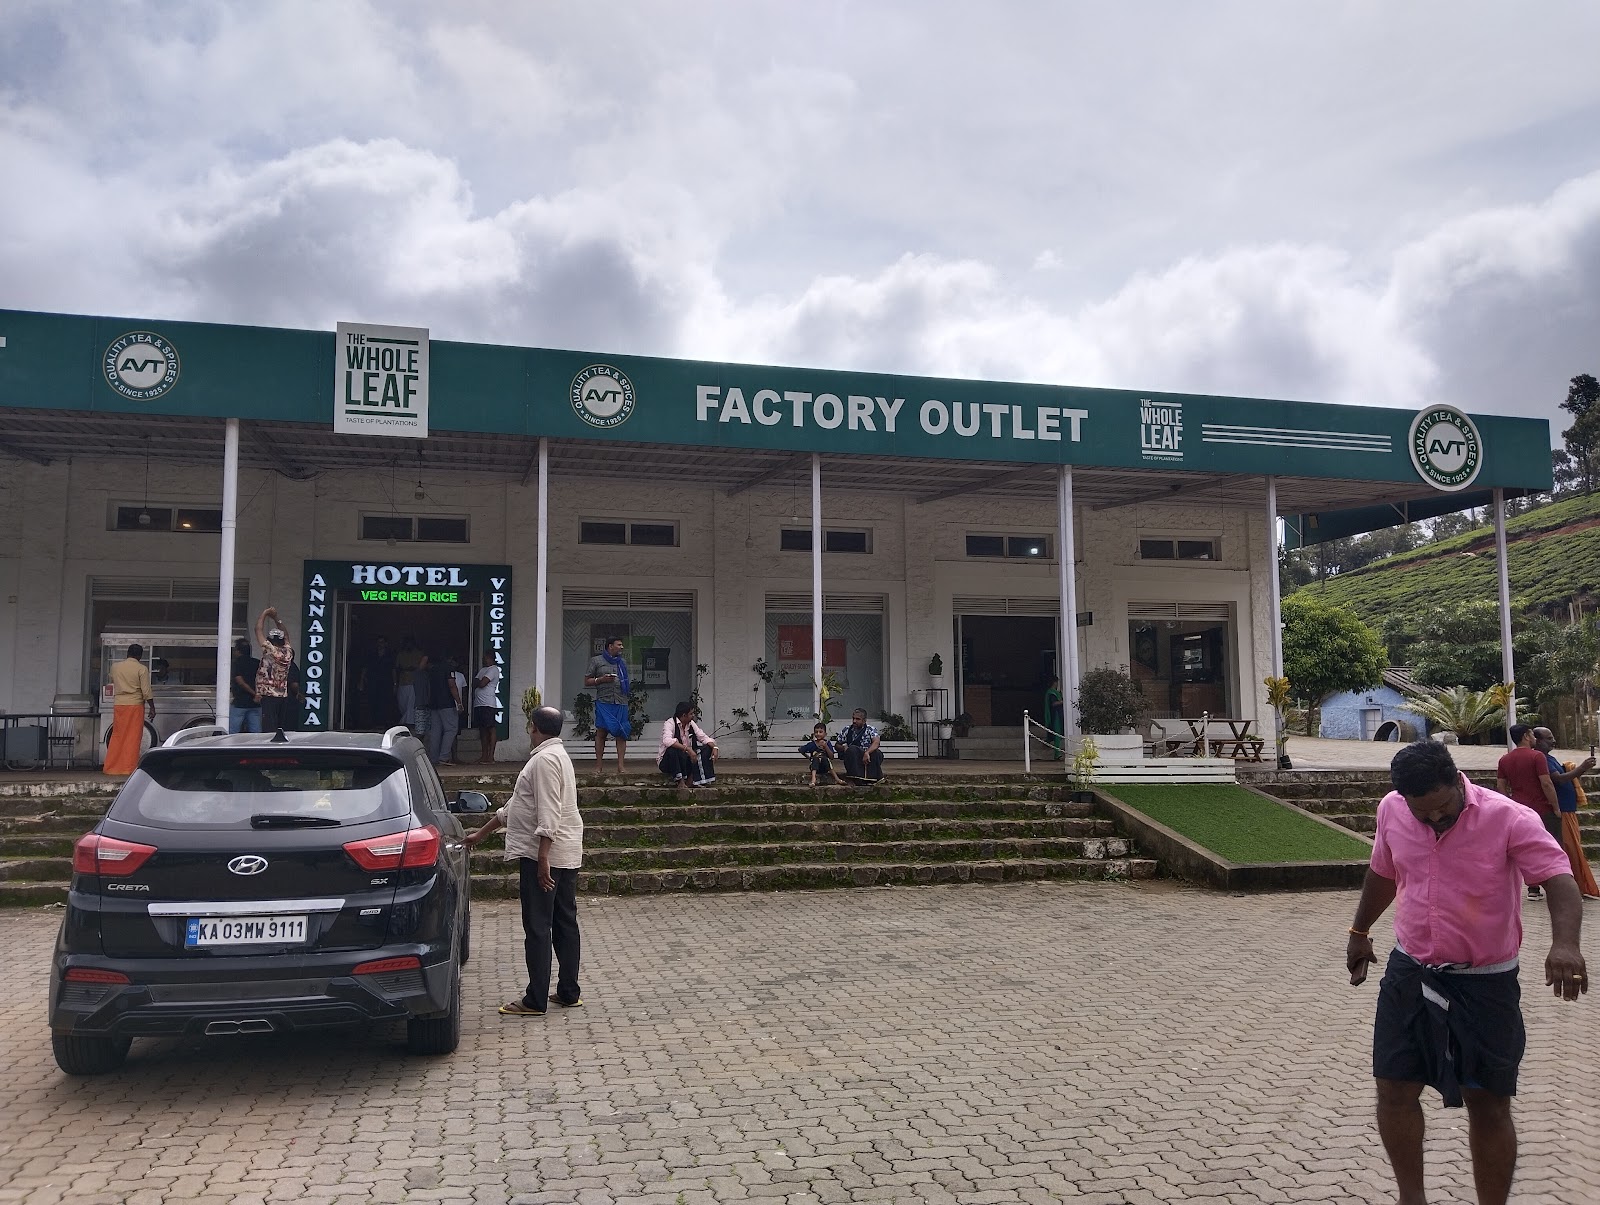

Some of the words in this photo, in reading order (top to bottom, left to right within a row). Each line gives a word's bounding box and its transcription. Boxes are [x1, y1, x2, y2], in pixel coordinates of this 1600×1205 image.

[347, 333, 365, 345] THE
[107, 338, 127, 380] QUALITY
[130, 334, 152, 343] TEA
[154, 339, 162, 348] &
[162, 346, 177, 383] SPICES
[119, 358, 164, 373] AVT
[346, 346, 419, 373] WHOLE
[118, 384, 143, 397] SINCE
[145, 386, 163, 397] 1925
[345, 370, 419, 409] LEAF
[573, 370, 590, 409] QUALITY
[591, 367, 611, 376] TEA
[612, 371, 620, 380] &
[620, 378, 633, 413] SPICES
[584, 388, 621, 403] AVT
[1140, 399, 1151, 407] THE
[583, 413, 605, 426] SINCE
[606, 415, 622, 426] 1925
[696, 385, 906, 433] FACTORY
[919, 400, 1089, 442] OUTLET
[1140, 407, 1183, 426] WHOLE
[375, 419, 418, 427] PLANTATIONS
[1141, 424, 1183, 450] LEAF
[1416, 416, 1432, 464] QUALITY
[1433, 412, 1453, 422] TEA
[1454, 417, 1461, 427] &
[1462, 425, 1476, 467] SPICES
[1428, 439, 1466, 456] AVT
[1429, 469, 1451, 483] SINCE
[1452, 471, 1467, 483] 1925
[351, 564, 468, 587] HOTEL
[361, 590, 388, 602] VEG
[390, 591, 427, 602] FRIED
[429, 591, 458, 603] RICE
[303, 573, 327, 726] ANNAPOORNA
[107, 883, 150, 891] CRETA
[198, 923, 218, 940] KA
[222, 922, 265, 939] 03MW
[268, 921, 303, 938] 9111
